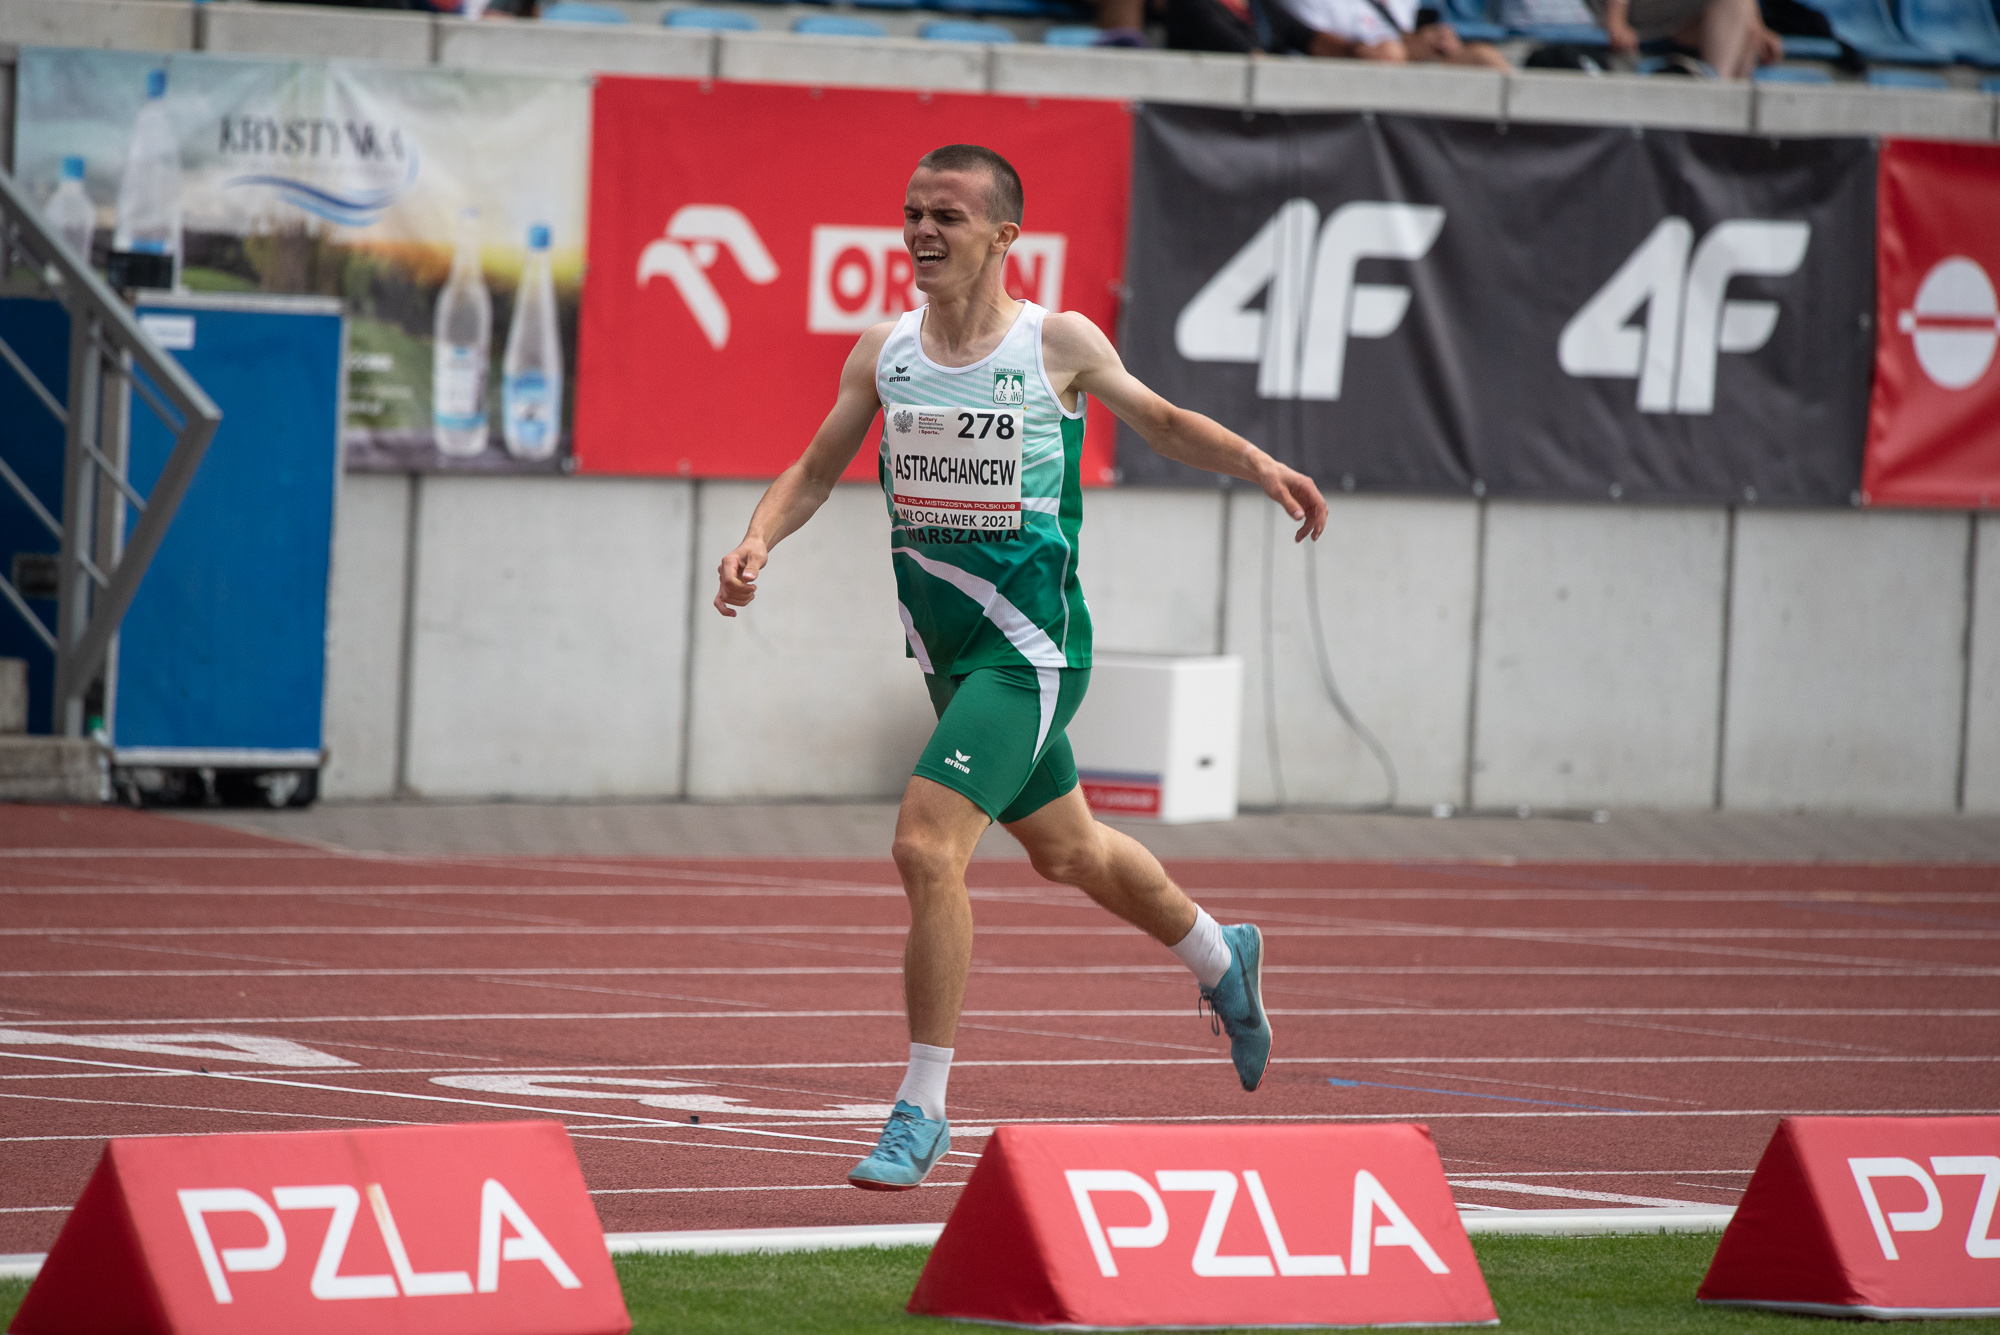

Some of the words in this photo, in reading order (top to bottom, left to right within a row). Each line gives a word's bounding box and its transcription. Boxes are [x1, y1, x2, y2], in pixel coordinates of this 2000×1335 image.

[829, 245, 1044, 317] ORN
[1175, 199, 1446, 400] 4F
[1558, 217, 1810, 414] 4F
[889, 375, 911, 383] erima
[994, 390, 1007, 402] AZS
[957, 412, 1015, 440] 278
[895, 454, 1016, 486] ASTRACHANCEW
[900, 508, 977, 527] WŁOCŁAWEK
[981, 515, 1013, 528] 2021
[925, 500, 973, 509] MISTRZOSTWA
[905, 527, 1020, 545] WARSZAWA
[944, 757, 971, 775] erima
[1064, 1168, 1451, 1278] PZLA
[176, 1177, 583, 1304] PZLA
